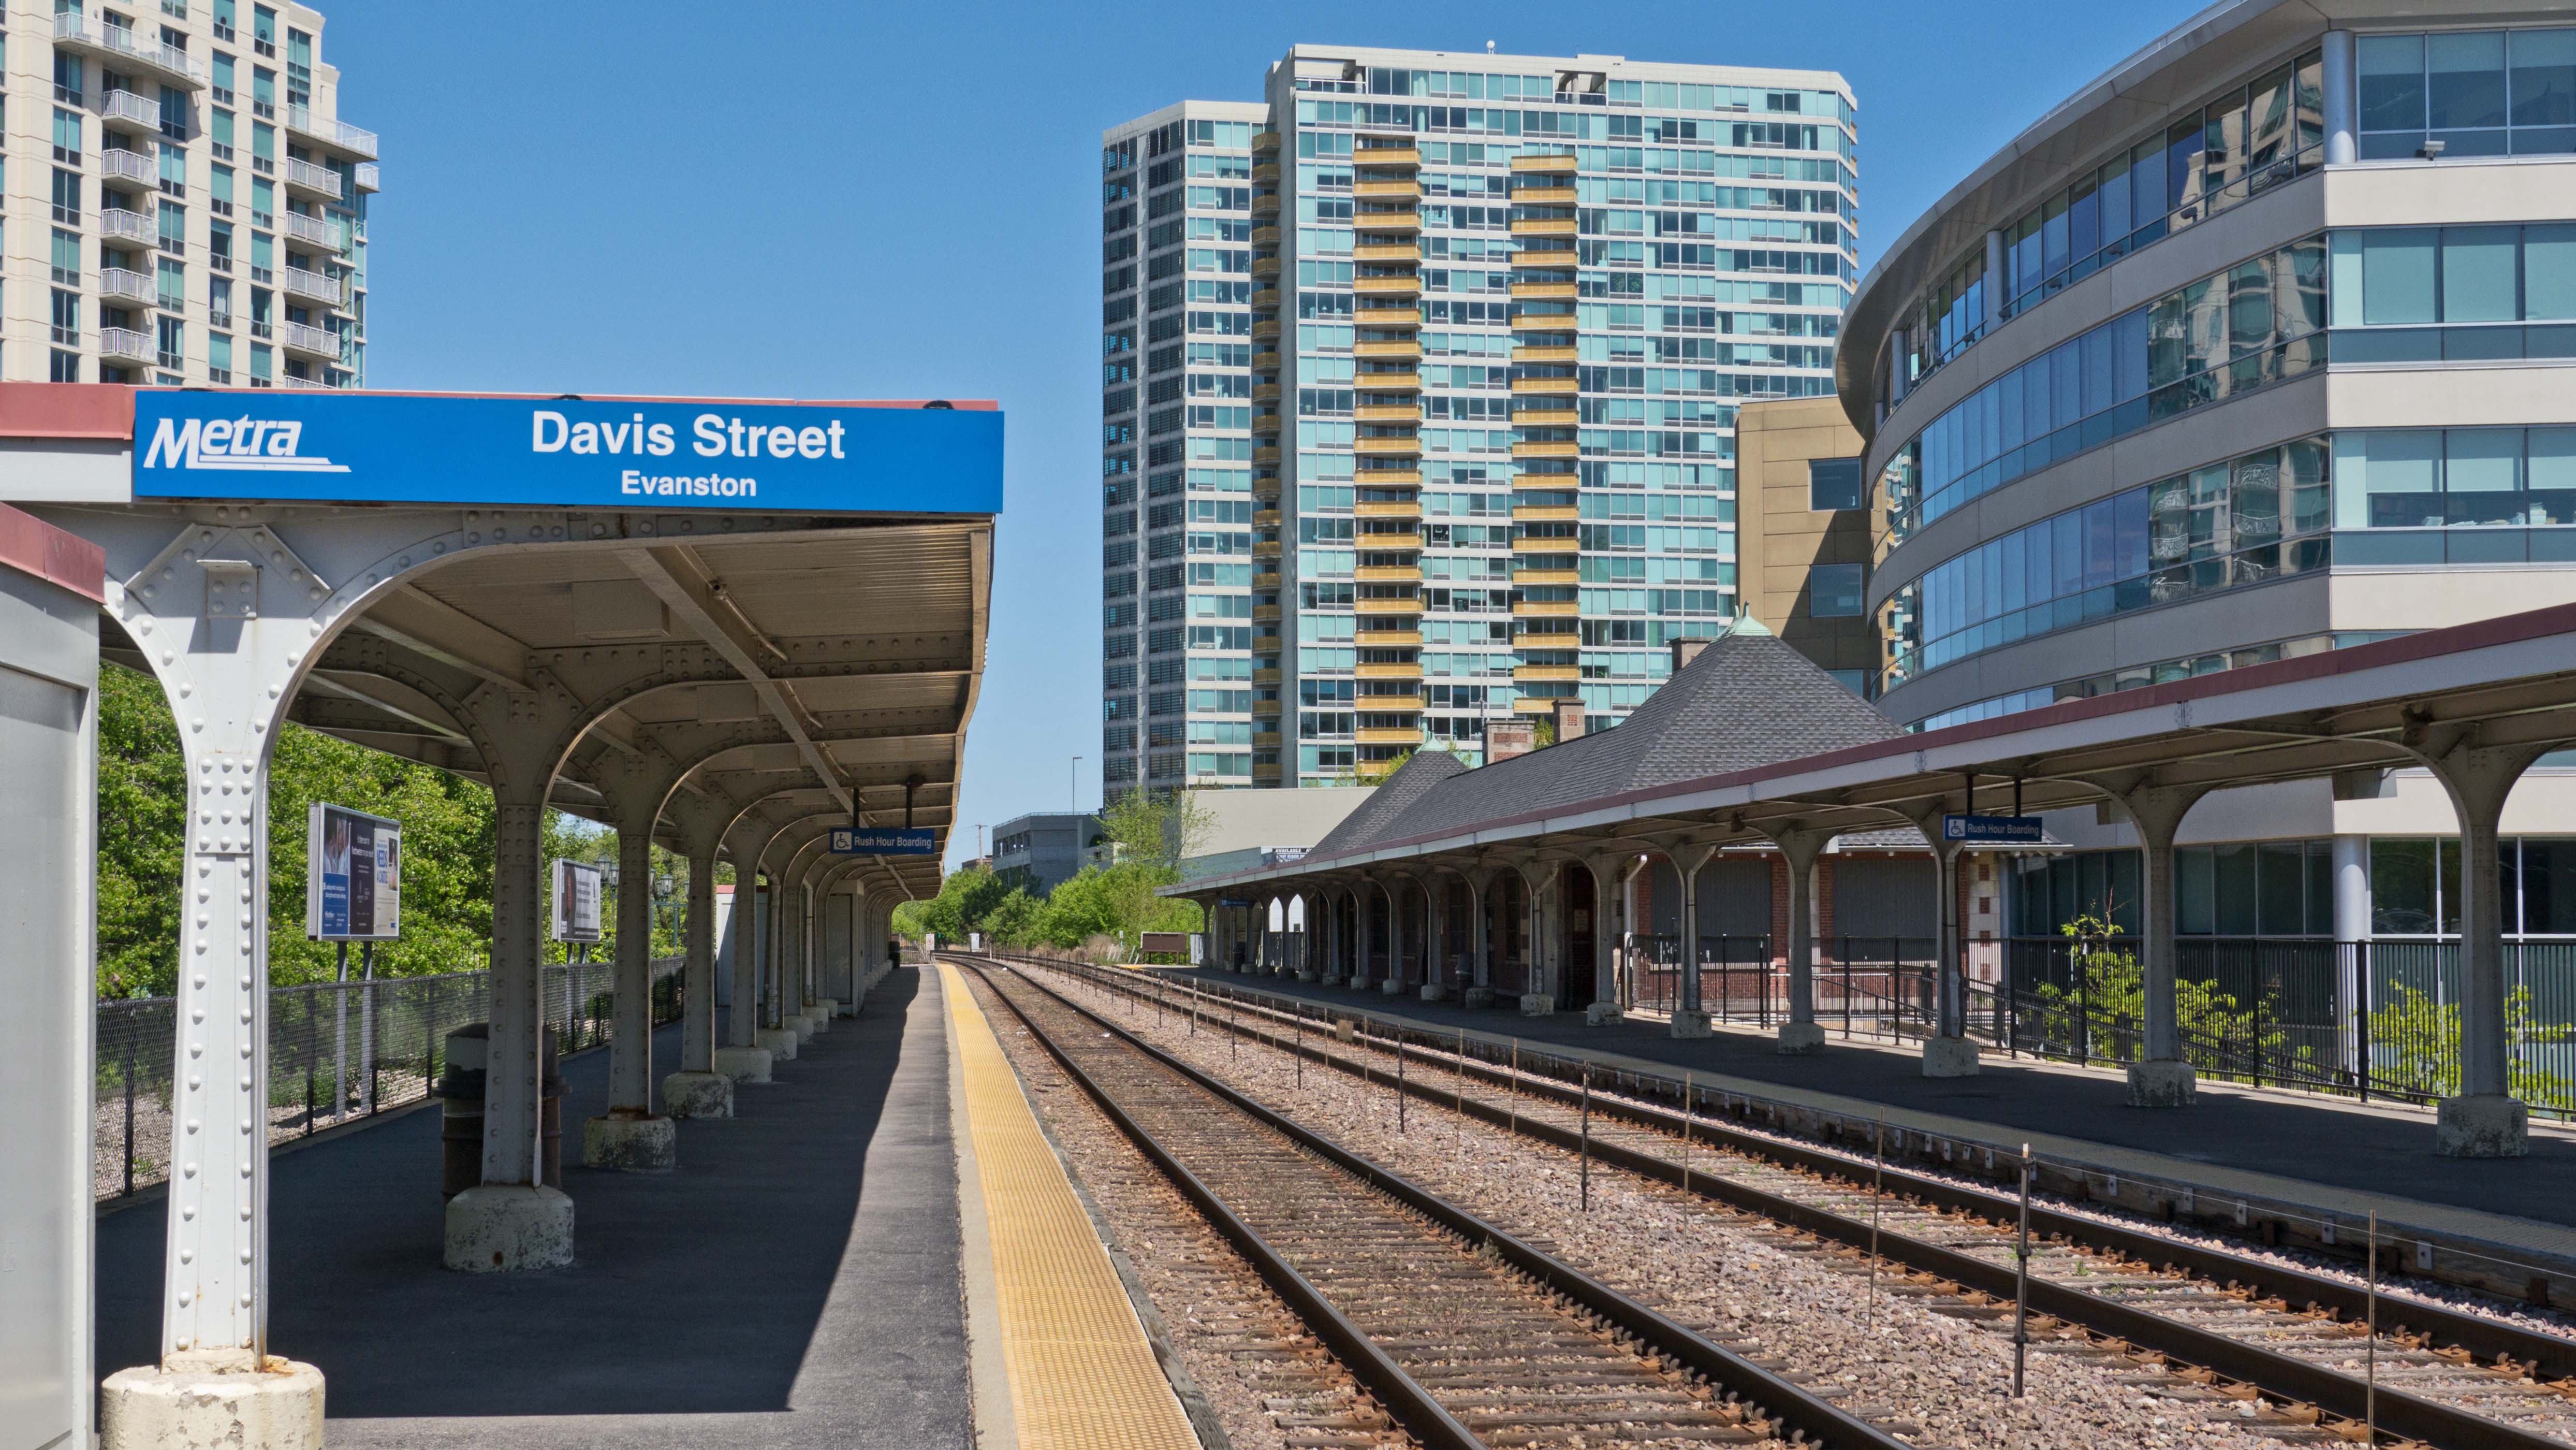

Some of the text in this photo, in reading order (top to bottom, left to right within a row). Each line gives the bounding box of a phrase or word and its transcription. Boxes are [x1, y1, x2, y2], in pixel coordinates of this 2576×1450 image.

[143, 414, 302, 469] Metra
[533, 411, 845, 459] Davis Street
[622, 470, 756, 497] Evanston
[854, 836, 931, 849] Rush Hour Boarding
[1968, 824, 2039, 836] Rush Hour Boarding
